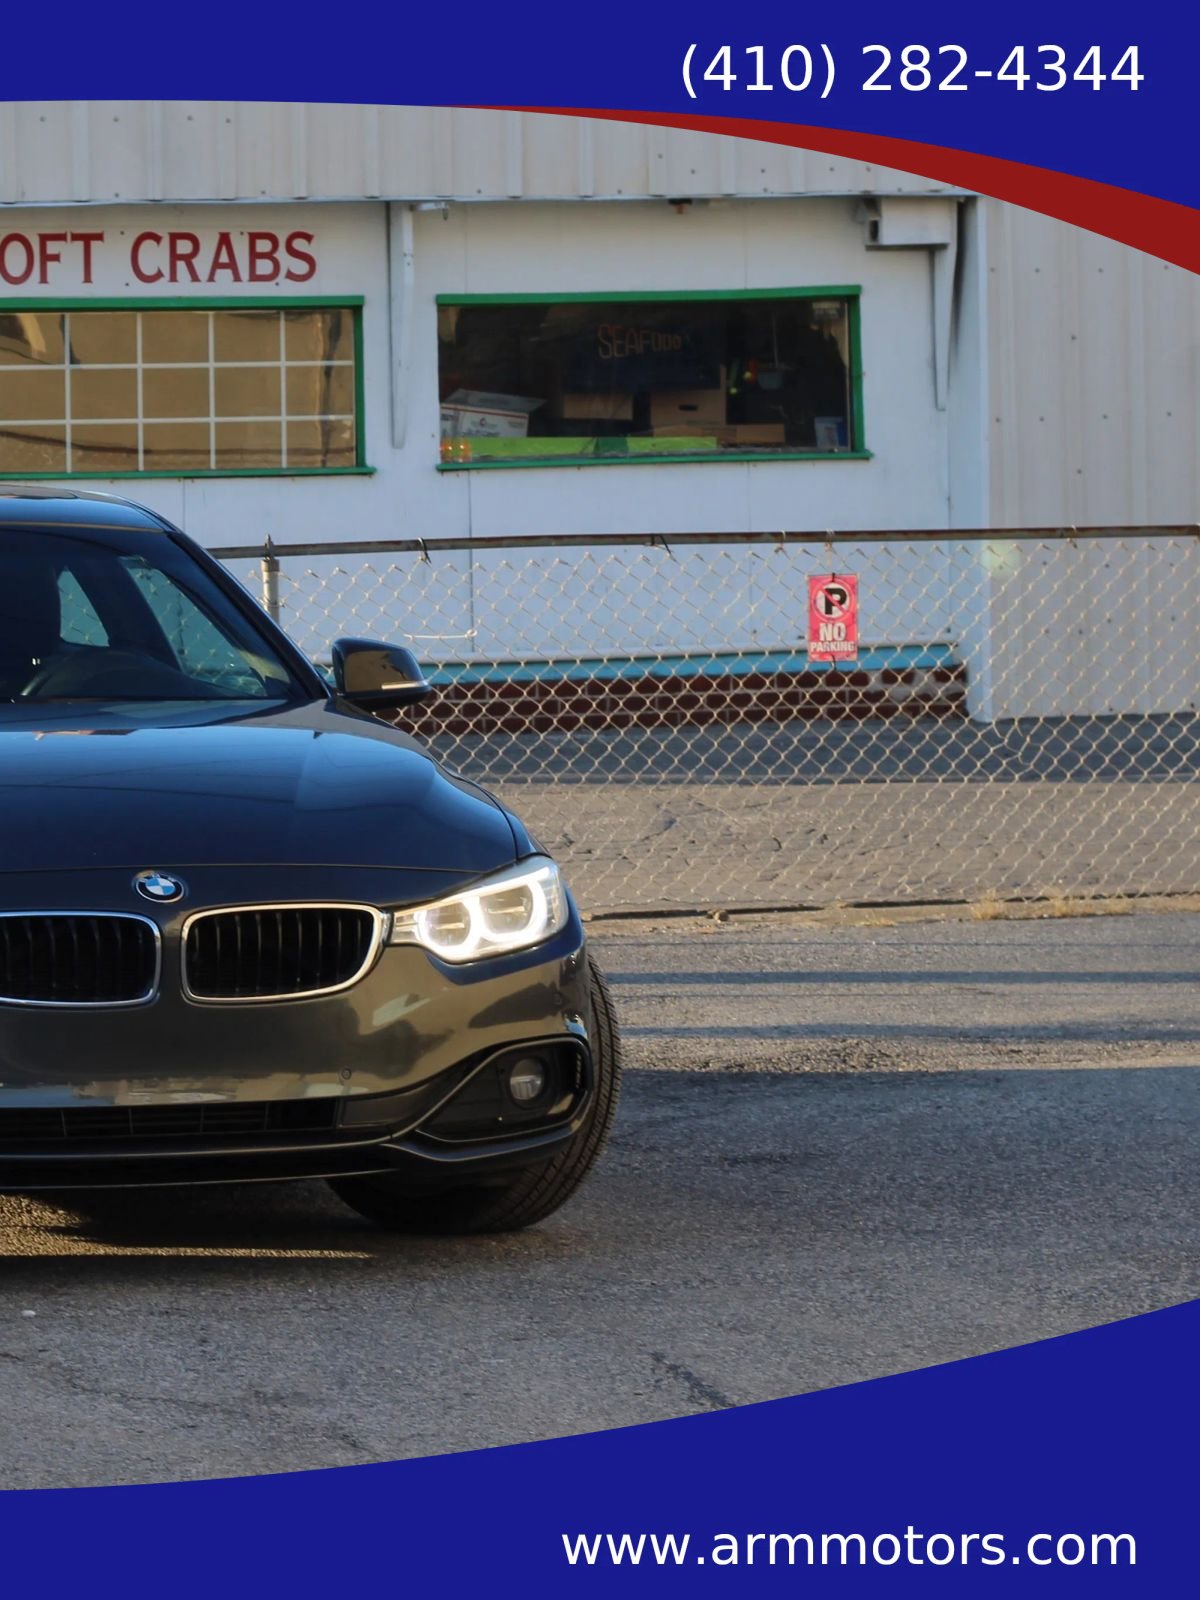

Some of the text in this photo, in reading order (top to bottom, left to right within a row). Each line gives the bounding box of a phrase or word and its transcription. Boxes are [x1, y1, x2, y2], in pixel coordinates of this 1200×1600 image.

[130, 231, 317, 284] CRABS
[819, 622, 847, 641] NO
[810, 641, 855, 653] PARKING
